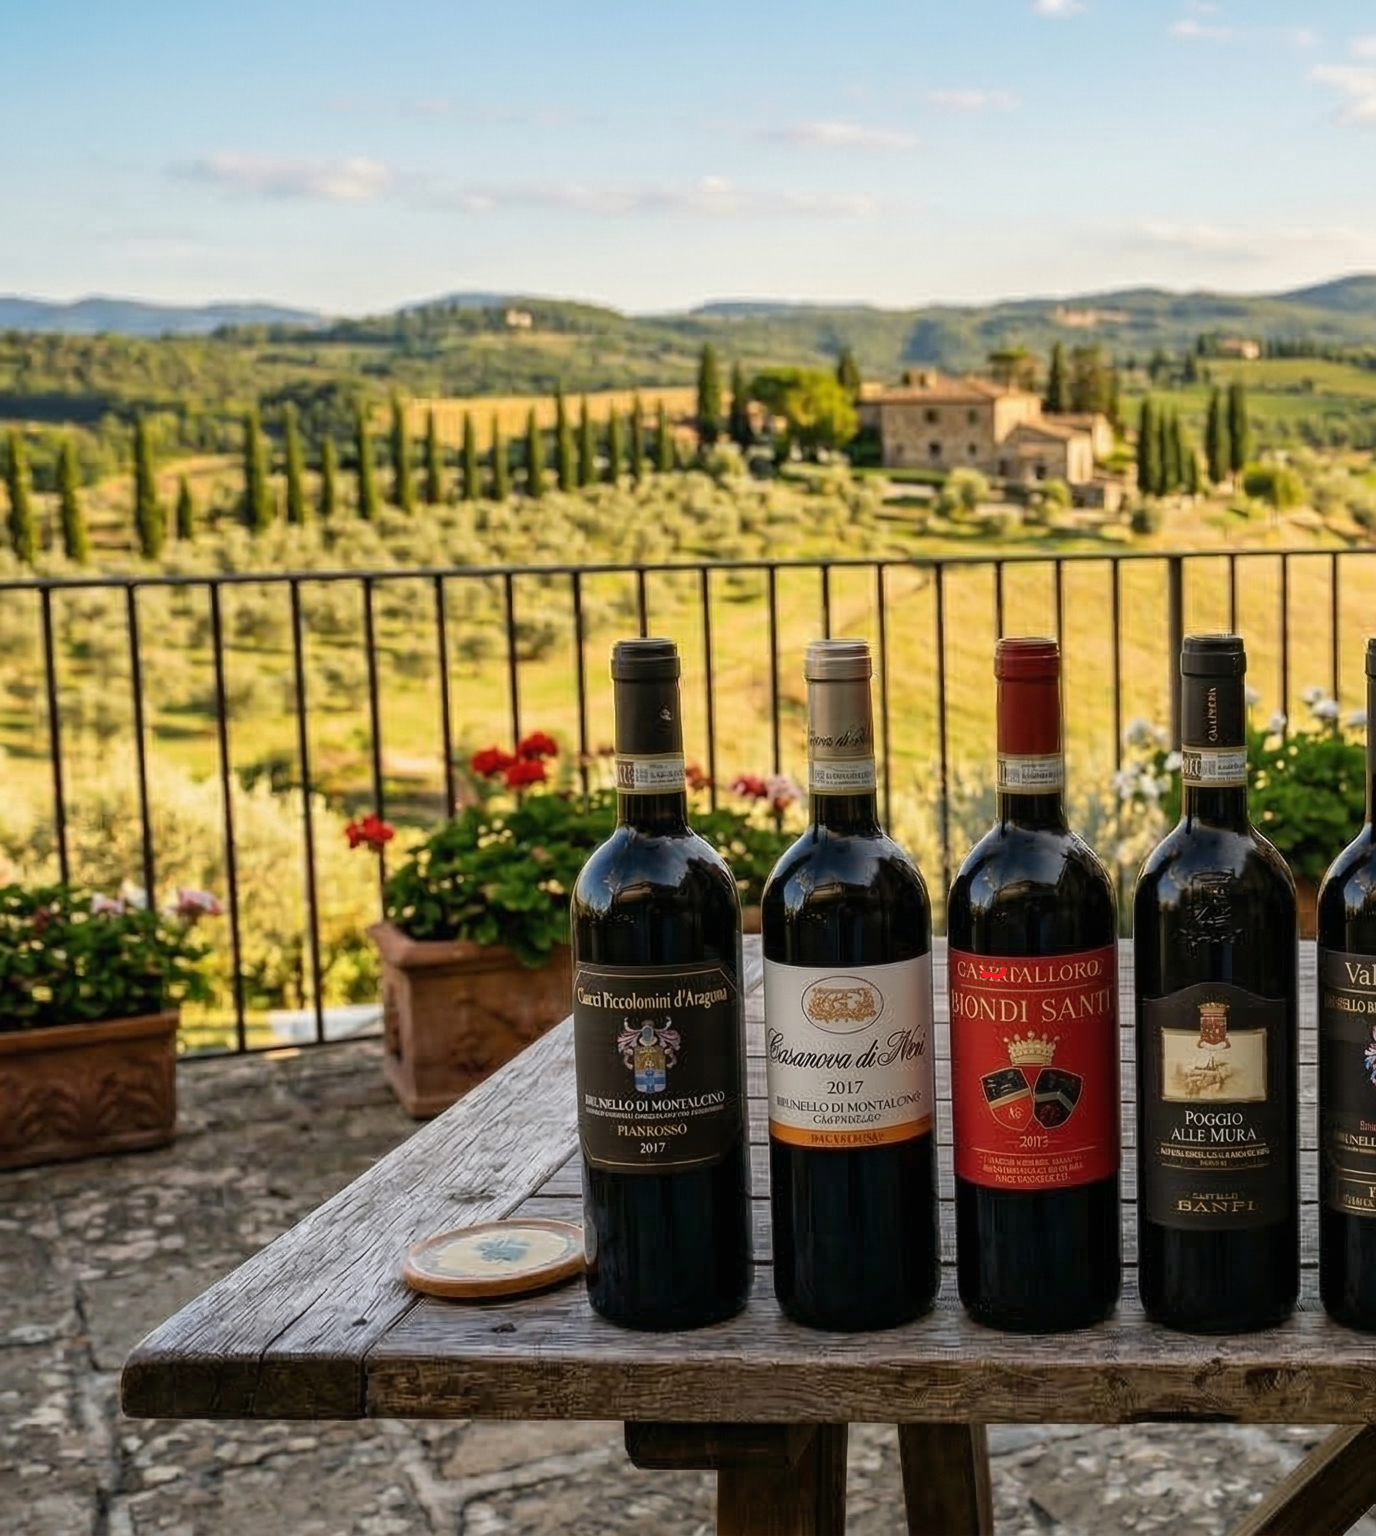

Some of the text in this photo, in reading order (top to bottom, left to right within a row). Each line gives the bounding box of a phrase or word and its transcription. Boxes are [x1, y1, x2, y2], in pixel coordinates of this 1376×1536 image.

[603, 991, 671, 1010] Piccolomini
[768, 1028, 852, 1069] Casanova
[856, 1039, 877, 1068] di
[827, 1080, 864, 1094] 2017
[636, 1101, 649, 1112] DI
[831, 1103, 844, 1113] DI
[1185, 1110, 1243, 1126] POGGIO
[617, 1123, 688, 1137] PIANROSSO
[1171, 1127, 1257, 1143] ALLE MURA
[640, 1142, 667, 1154] 2017
